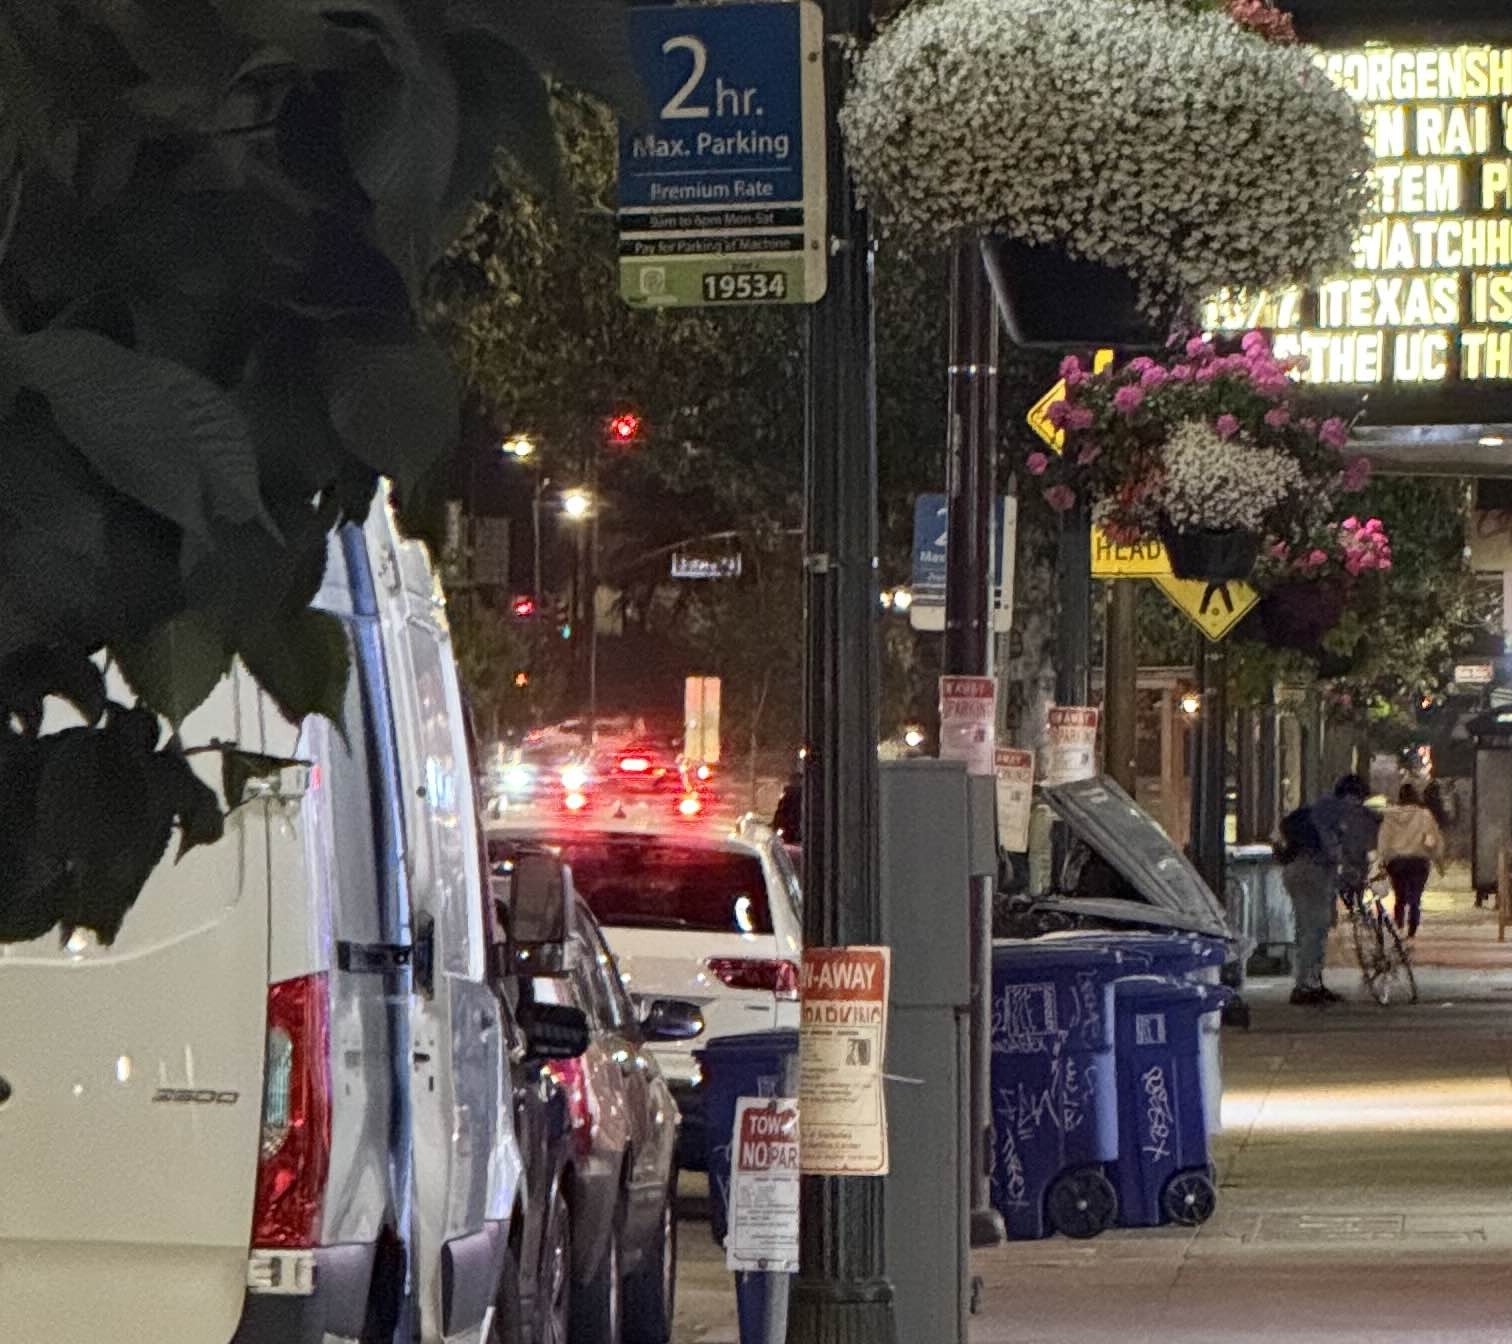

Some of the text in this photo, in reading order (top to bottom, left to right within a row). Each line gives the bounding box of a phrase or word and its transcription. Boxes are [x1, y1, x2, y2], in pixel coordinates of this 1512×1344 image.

[660, 35, 764, 119] 2 hr.
[632, 129, 790, 159] Max. Parking
[1415, 107, 1489, 156] RAI
[650, 180, 774, 201] Premium Rate
[676, 239, 723, 255] Parking
[704, 273, 785, 300] 19534
[1394, 330, 1449, 382] UC
[152, 1087, 240, 1104] 2500
